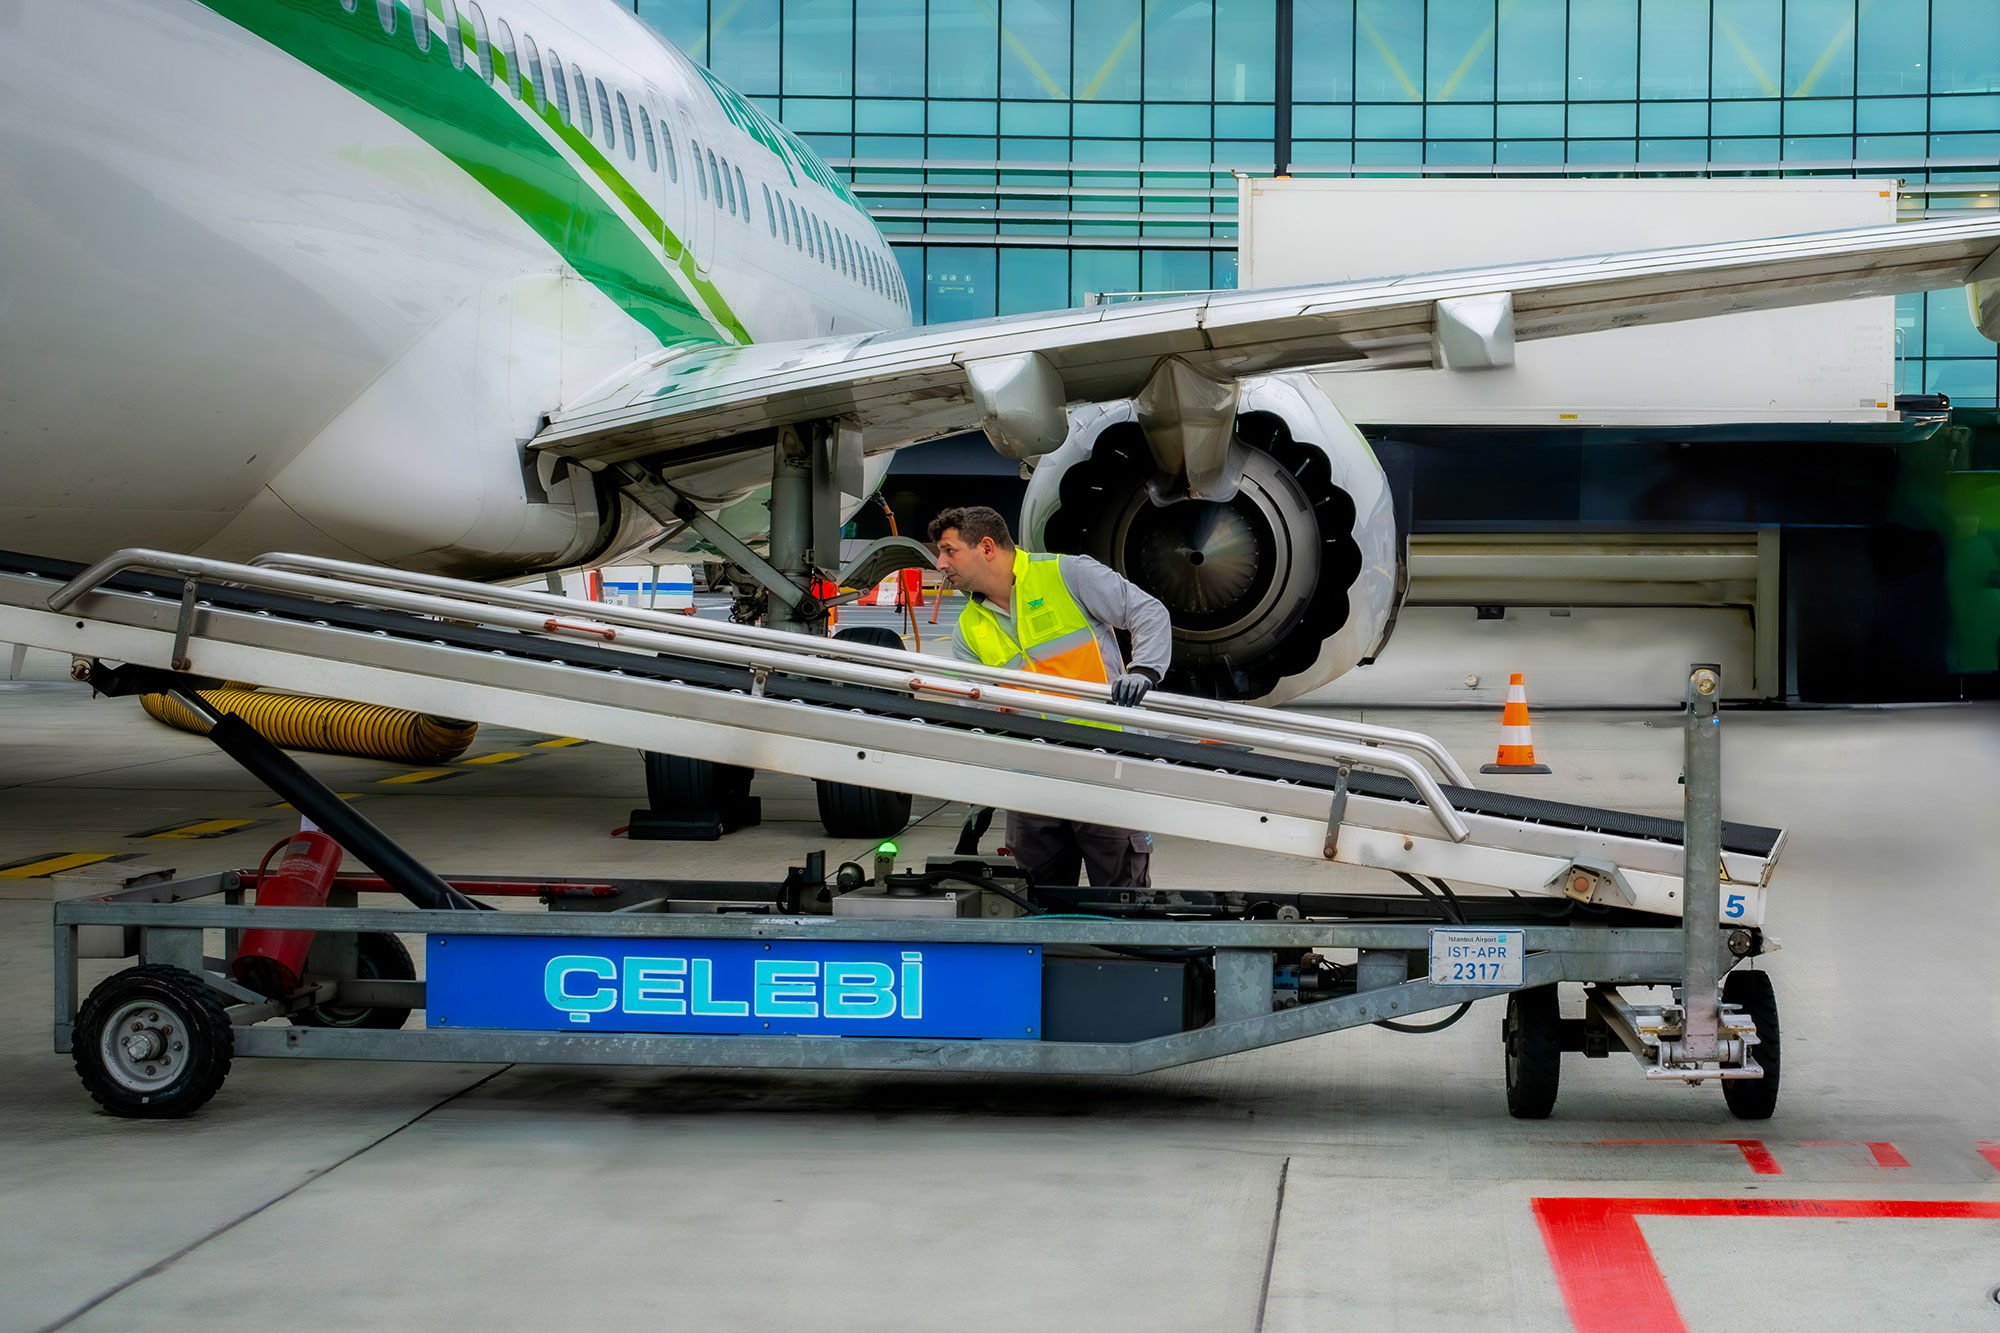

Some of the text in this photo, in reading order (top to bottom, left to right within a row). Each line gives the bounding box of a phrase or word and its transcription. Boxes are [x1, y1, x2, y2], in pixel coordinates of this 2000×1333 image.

[1724, 894, 1746, 918] 5
[1448, 935, 1497, 944] Istanbul Airport
[1447, 946, 1507, 958] IST-APR
[1453, 962, 1500, 980] 2317
[543, 951, 923, 1023] ÇELEBİ
